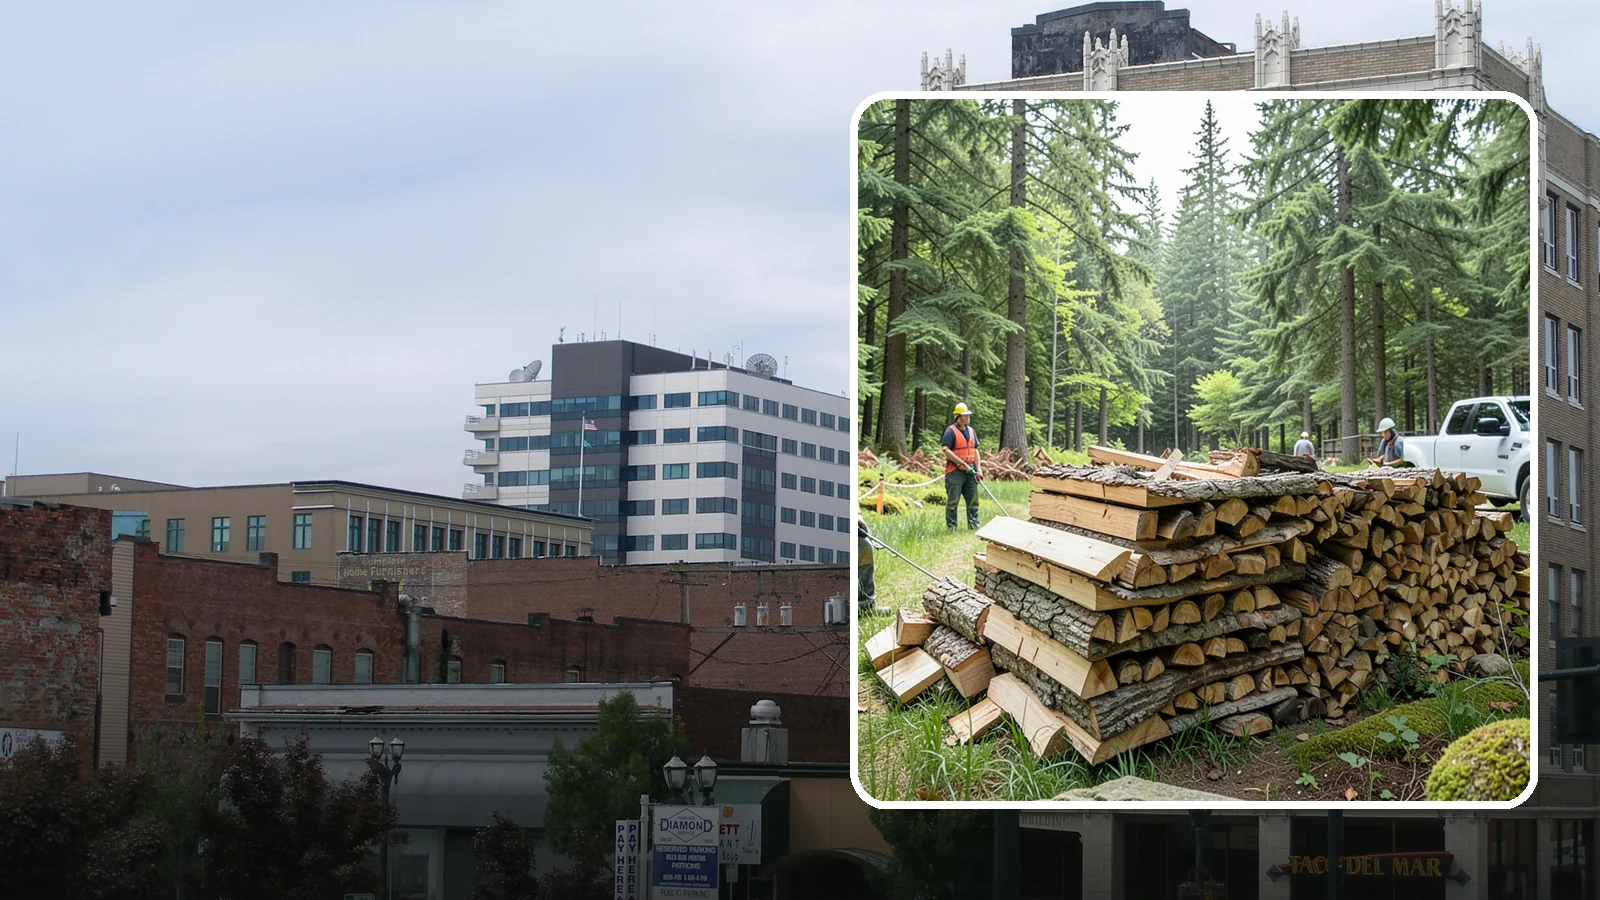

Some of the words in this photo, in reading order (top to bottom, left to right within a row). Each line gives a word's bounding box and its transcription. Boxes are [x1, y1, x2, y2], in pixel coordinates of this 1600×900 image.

[343, 568, 368, 577] Home
[370, 566, 427, 576] Furnishers
[660, 818, 713, 832] DIAMOND
[1022, 815, 1069, 828] BUILDING
[617, 825, 625, 852] PAY
[628, 825, 636, 852] PAY
[616, 856, 625, 893] HERE
[628, 856, 636, 893] HERE
[1346, 856, 1385, 875] DEL
[1392, 857, 1442, 877] MAR
[660, 889, 681, 897] PUBLIC
[683, 890, 710, 898] PARKING
